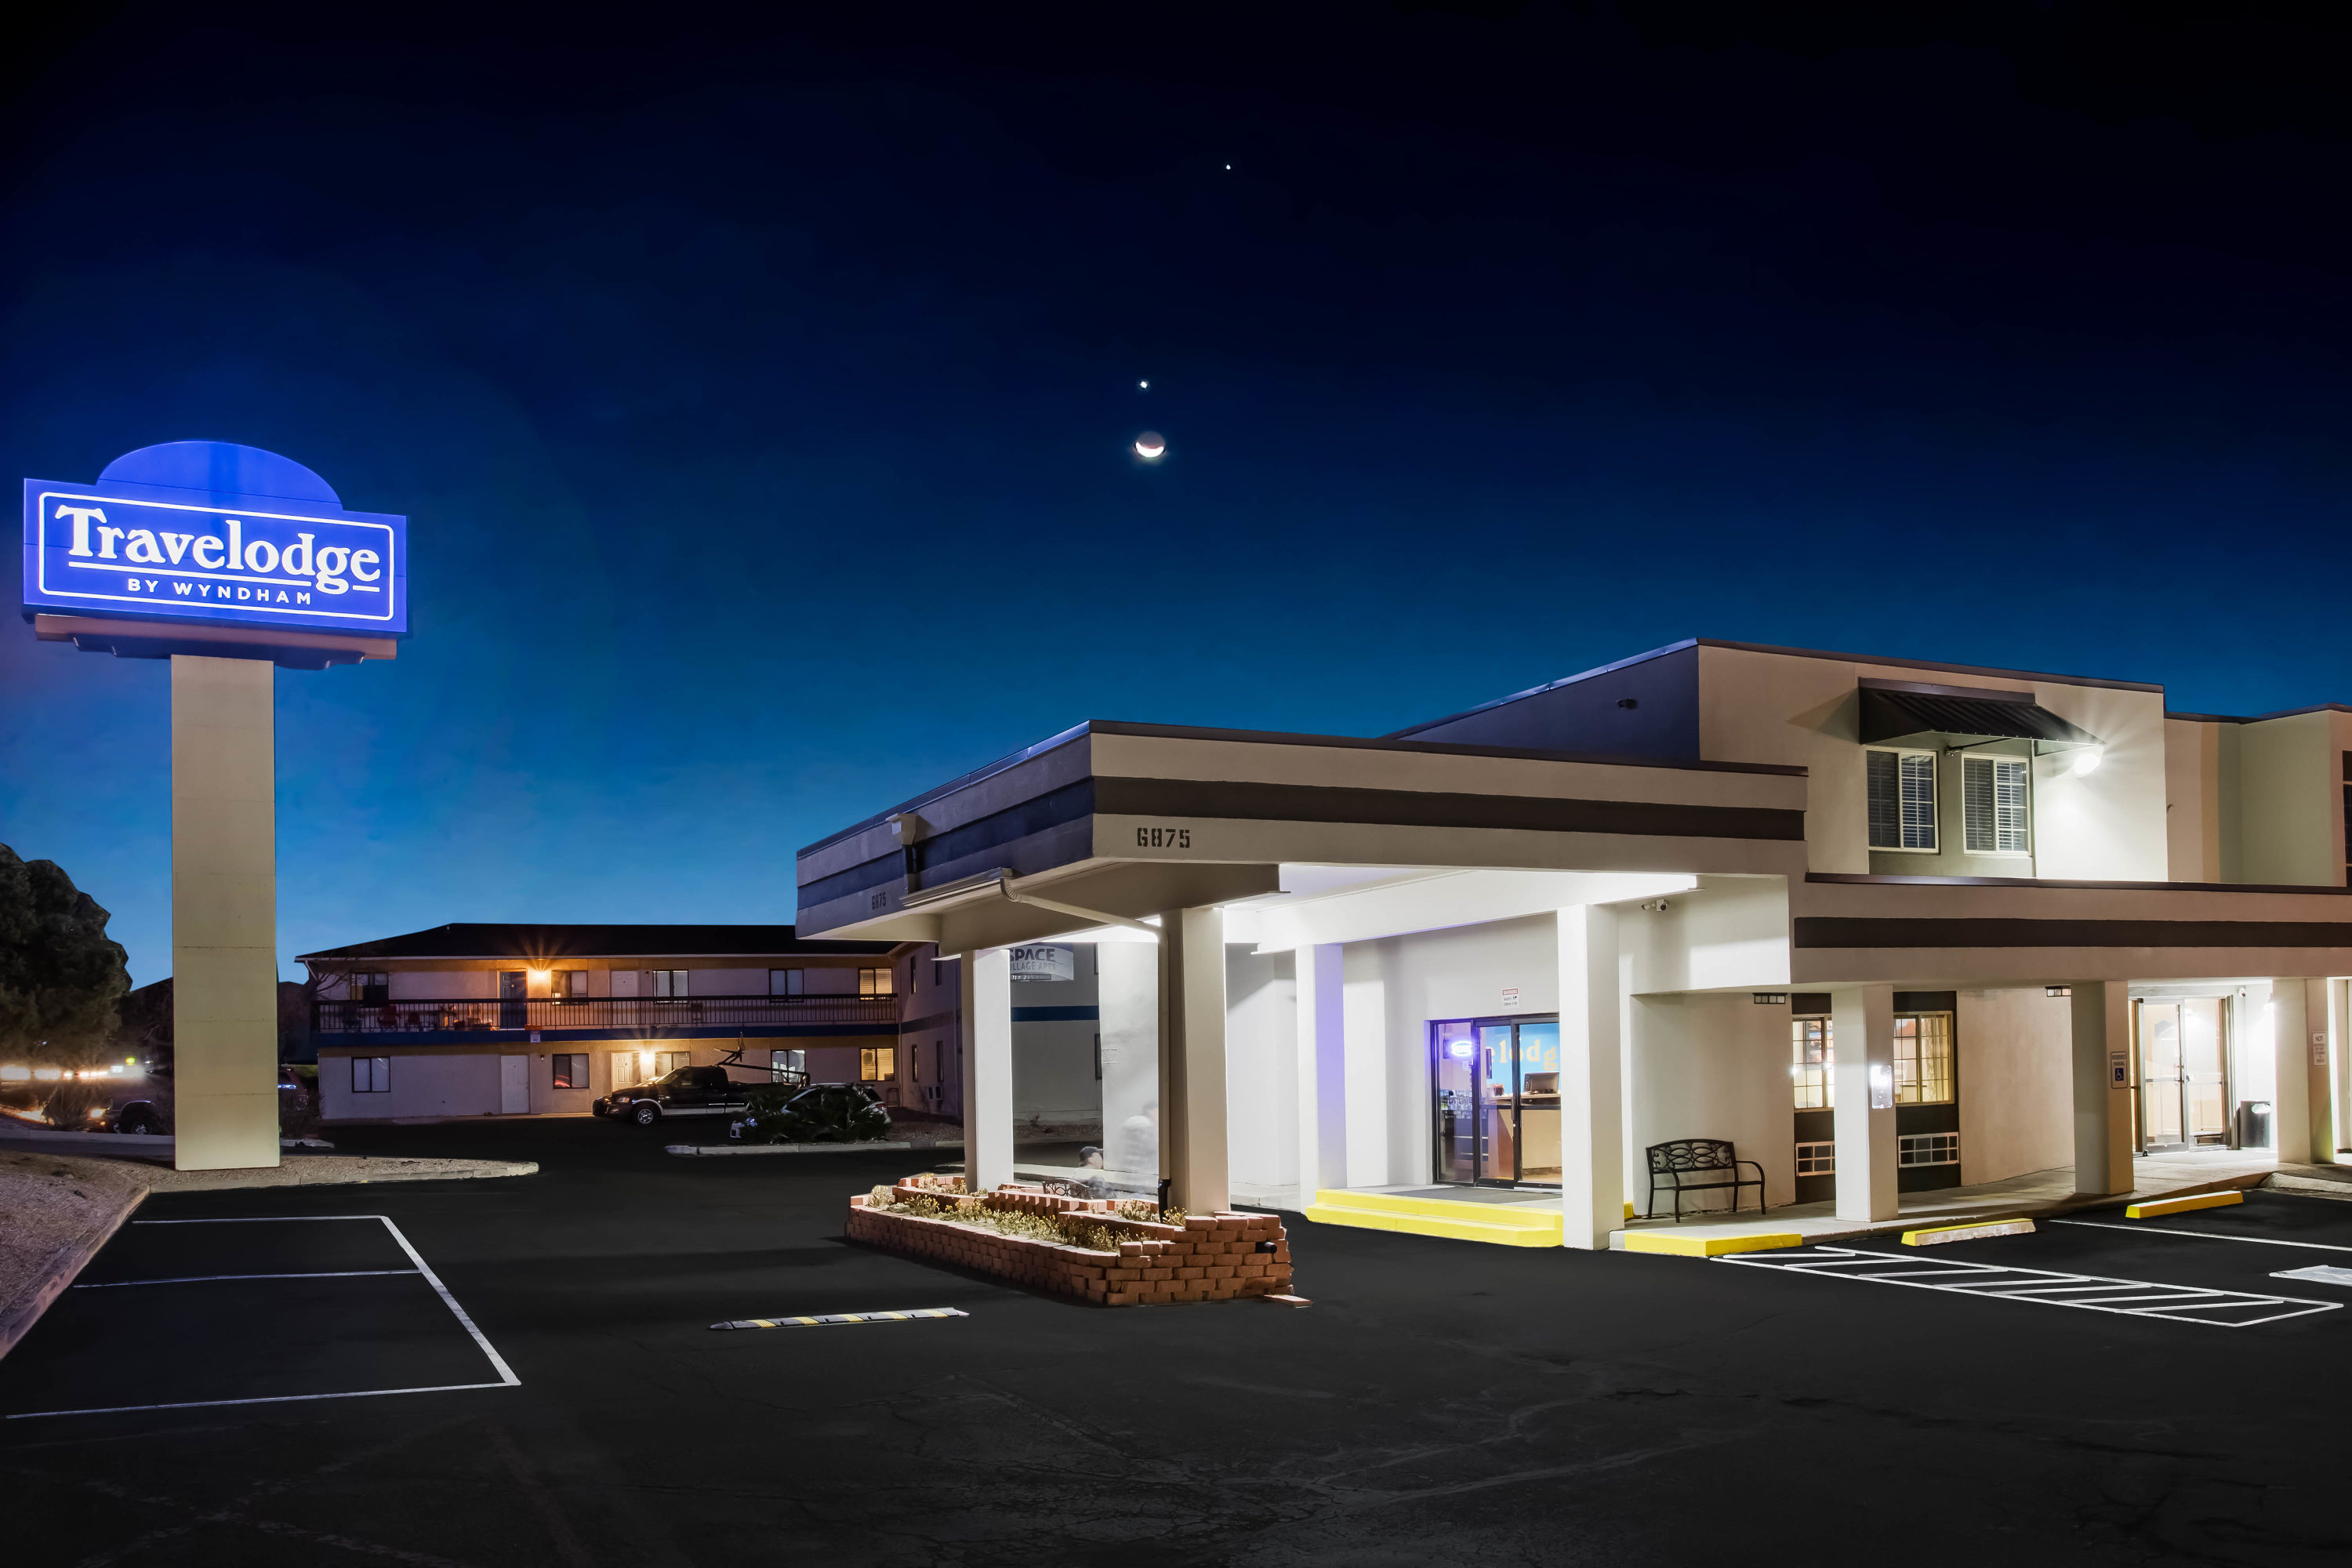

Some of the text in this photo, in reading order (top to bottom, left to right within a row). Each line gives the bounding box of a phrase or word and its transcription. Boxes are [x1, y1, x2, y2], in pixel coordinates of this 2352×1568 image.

[55, 504, 381, 596] Travelodge
[127, 578, 312, 606] BY WYNDHAM
[1137, 827, 1191, 848] 6875
[871, 891, 887, 910] 6875
[1010, 961, 1035, 971] ILLAGE
